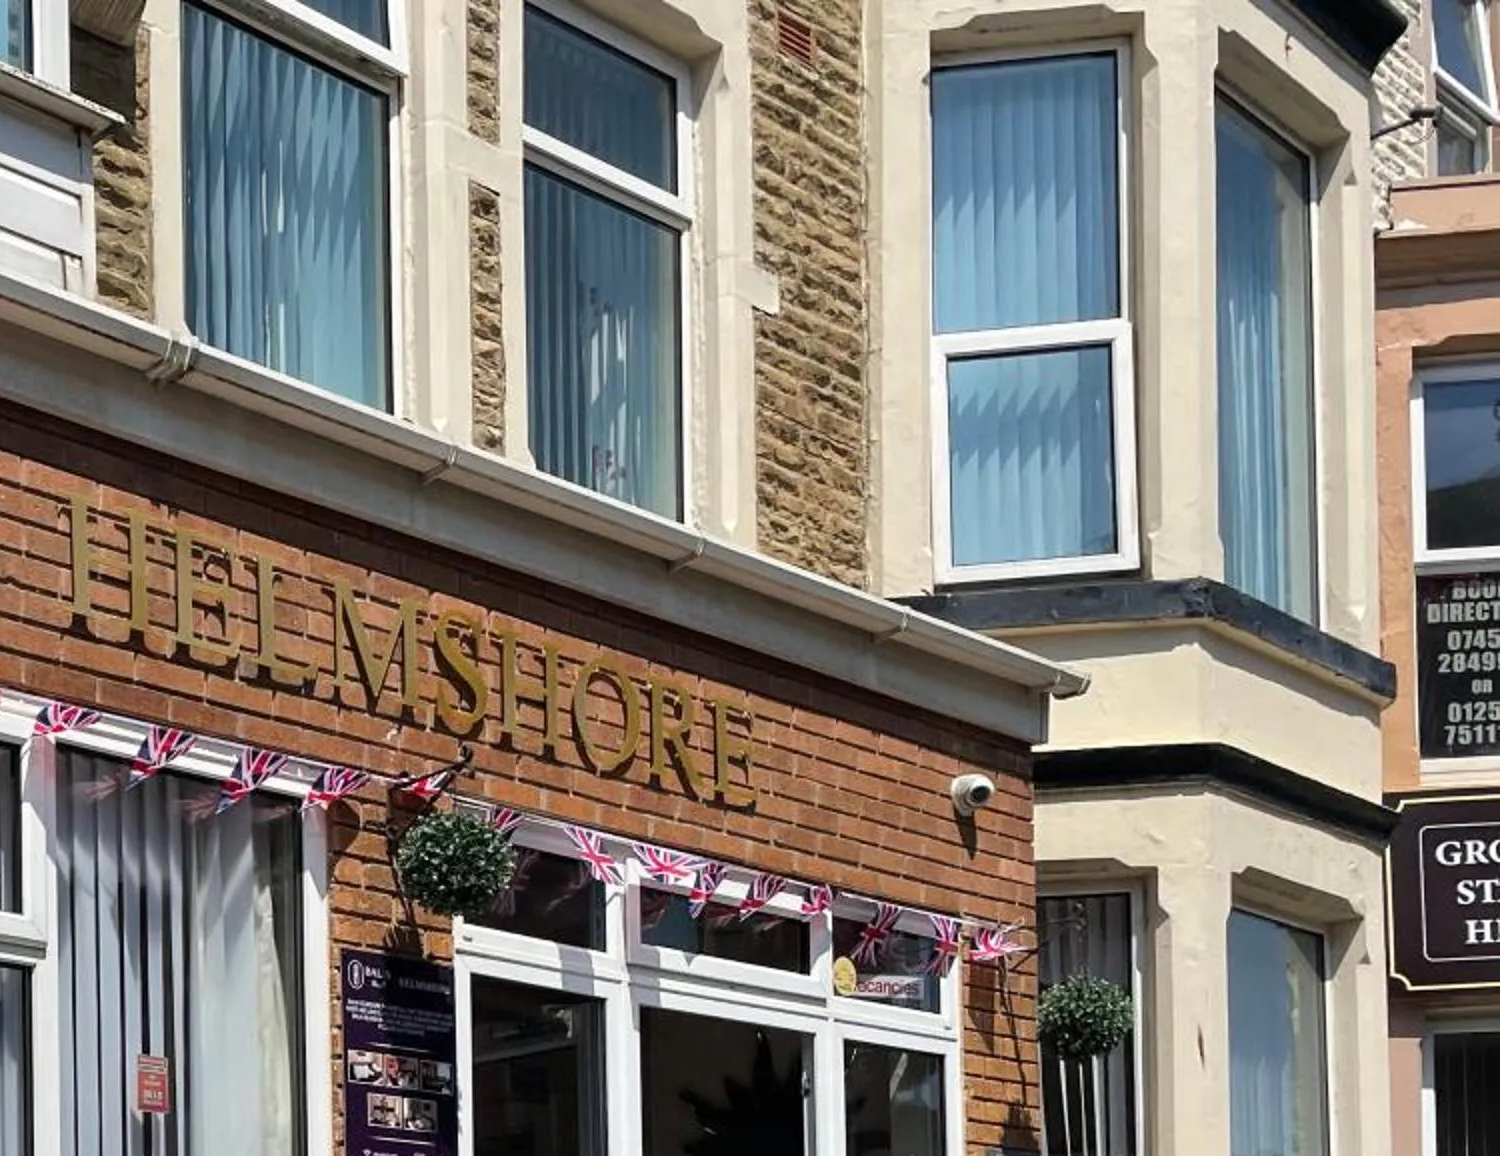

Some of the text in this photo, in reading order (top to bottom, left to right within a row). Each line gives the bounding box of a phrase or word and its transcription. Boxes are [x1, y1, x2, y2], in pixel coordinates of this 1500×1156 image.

[1452, 579, 1500, 600] BOO
[1426, 601, 1500, 624] DIRECT
[60, 497, 762, 806] HELMSHORE
[1437, 651, 1500, 673] 2849
[1471, 679, 1493, 694] OR
[1447, 701, 1500, 723] 0125
[1443, 724, 1500, 745] 7511
[1456, 879, 1500, 905] ST
[1465, 918, 1500, 944] H
[855, 979, 918, 995] acancies
